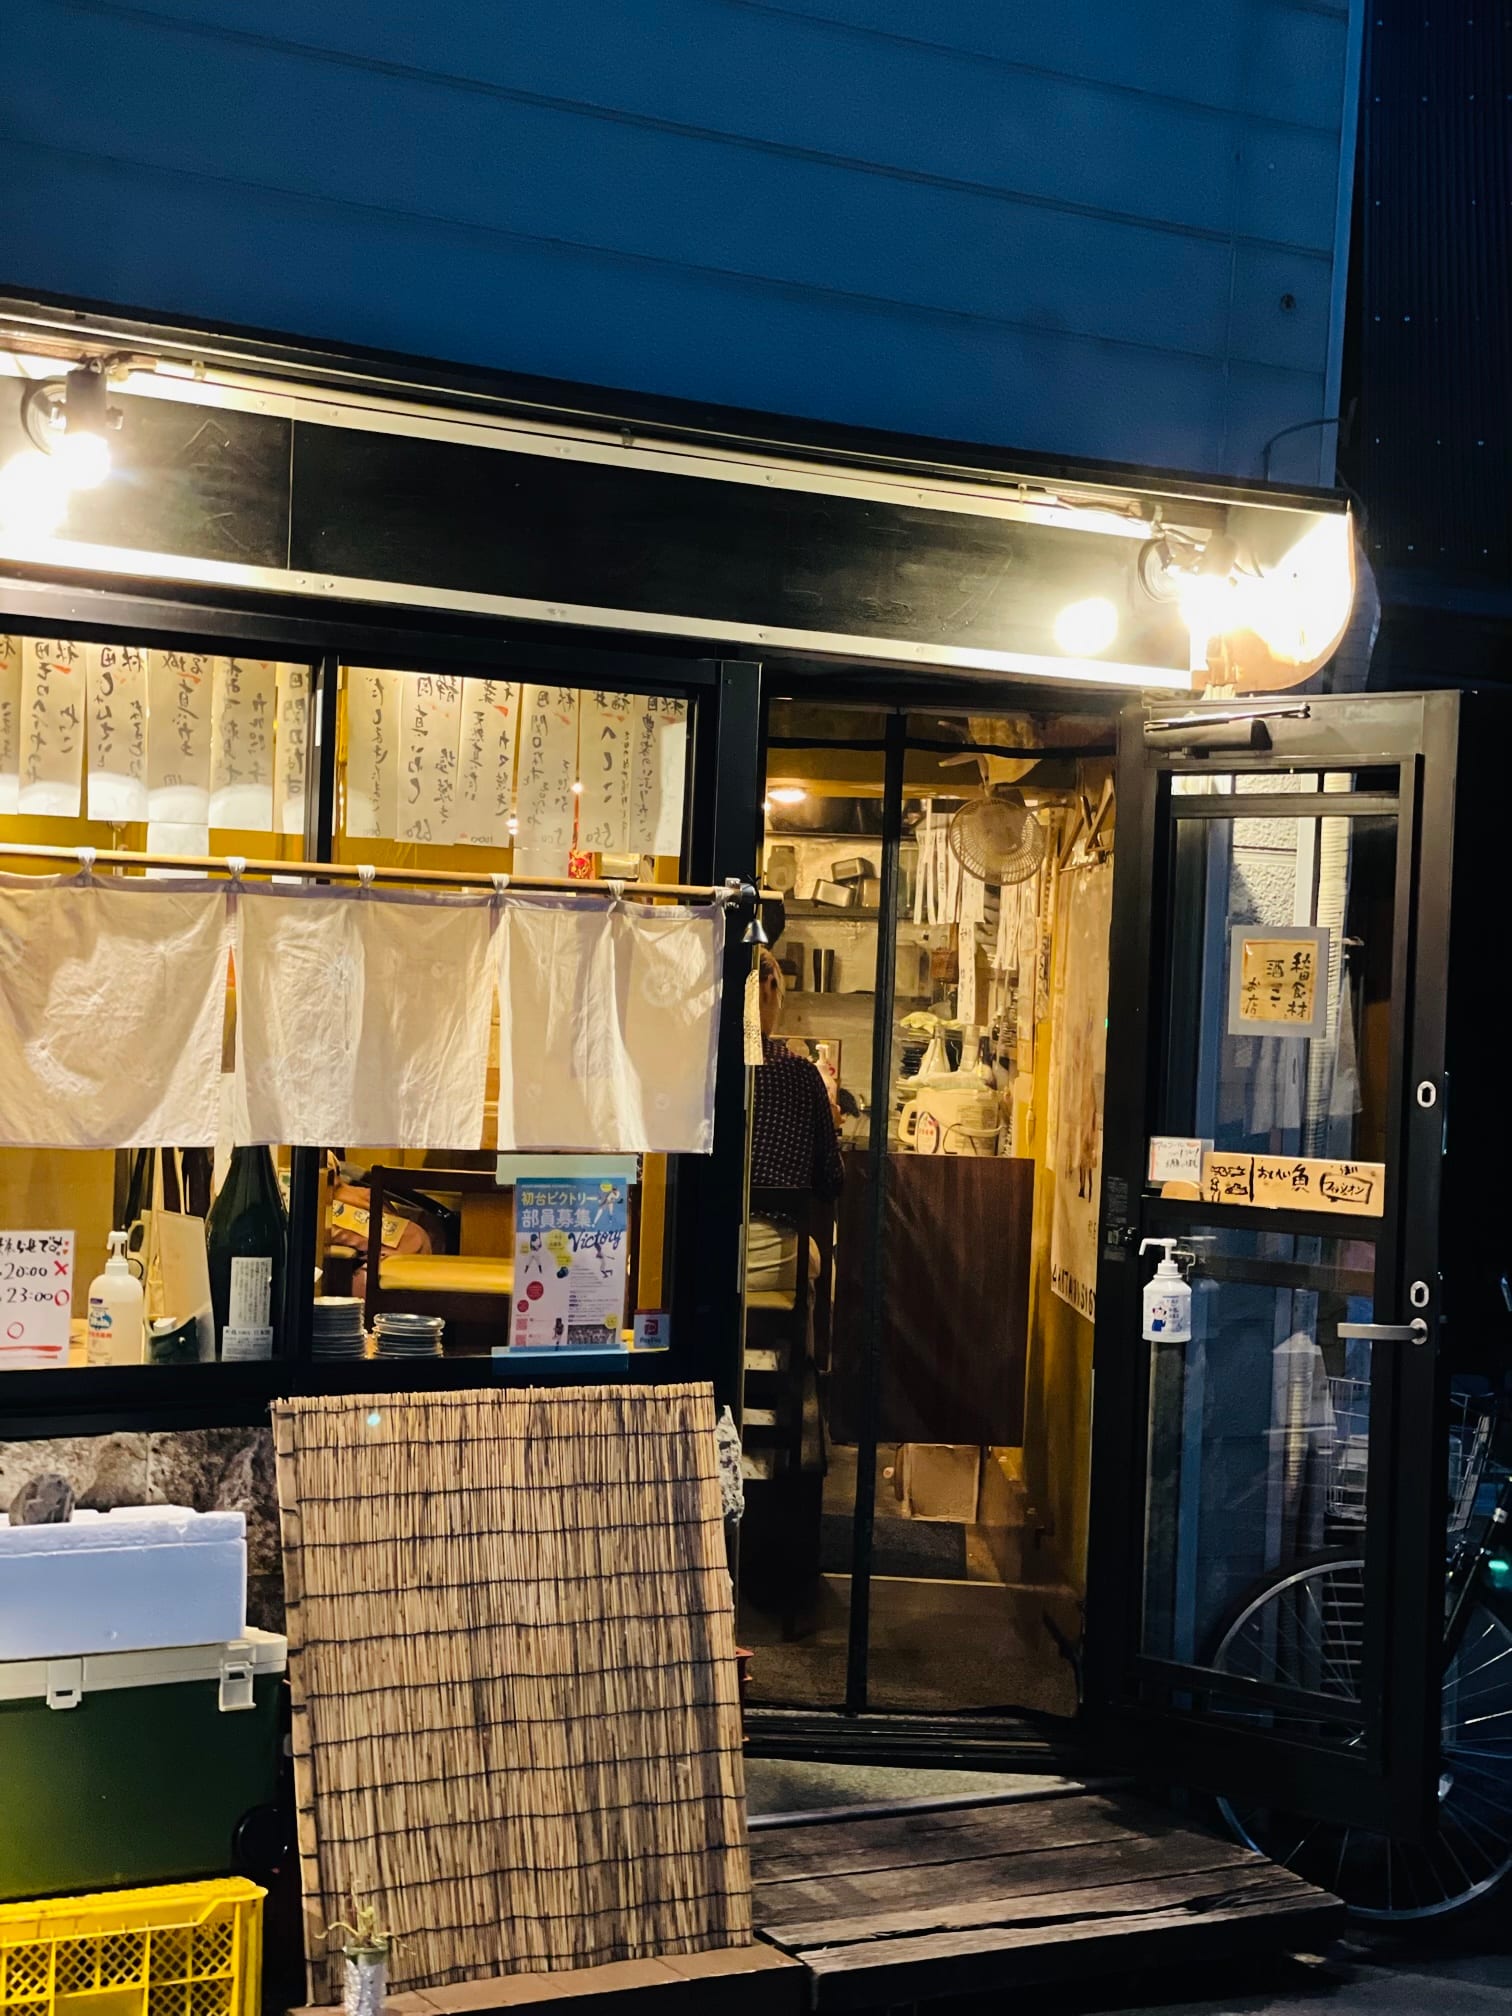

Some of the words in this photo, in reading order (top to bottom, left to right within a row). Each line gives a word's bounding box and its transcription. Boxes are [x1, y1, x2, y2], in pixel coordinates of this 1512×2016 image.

[521, 1191, 598, 1206] 初台ビクトリー
[568, 1229, 622, 1252] Victory
[7, 1287, 54, 1303] 23:00
